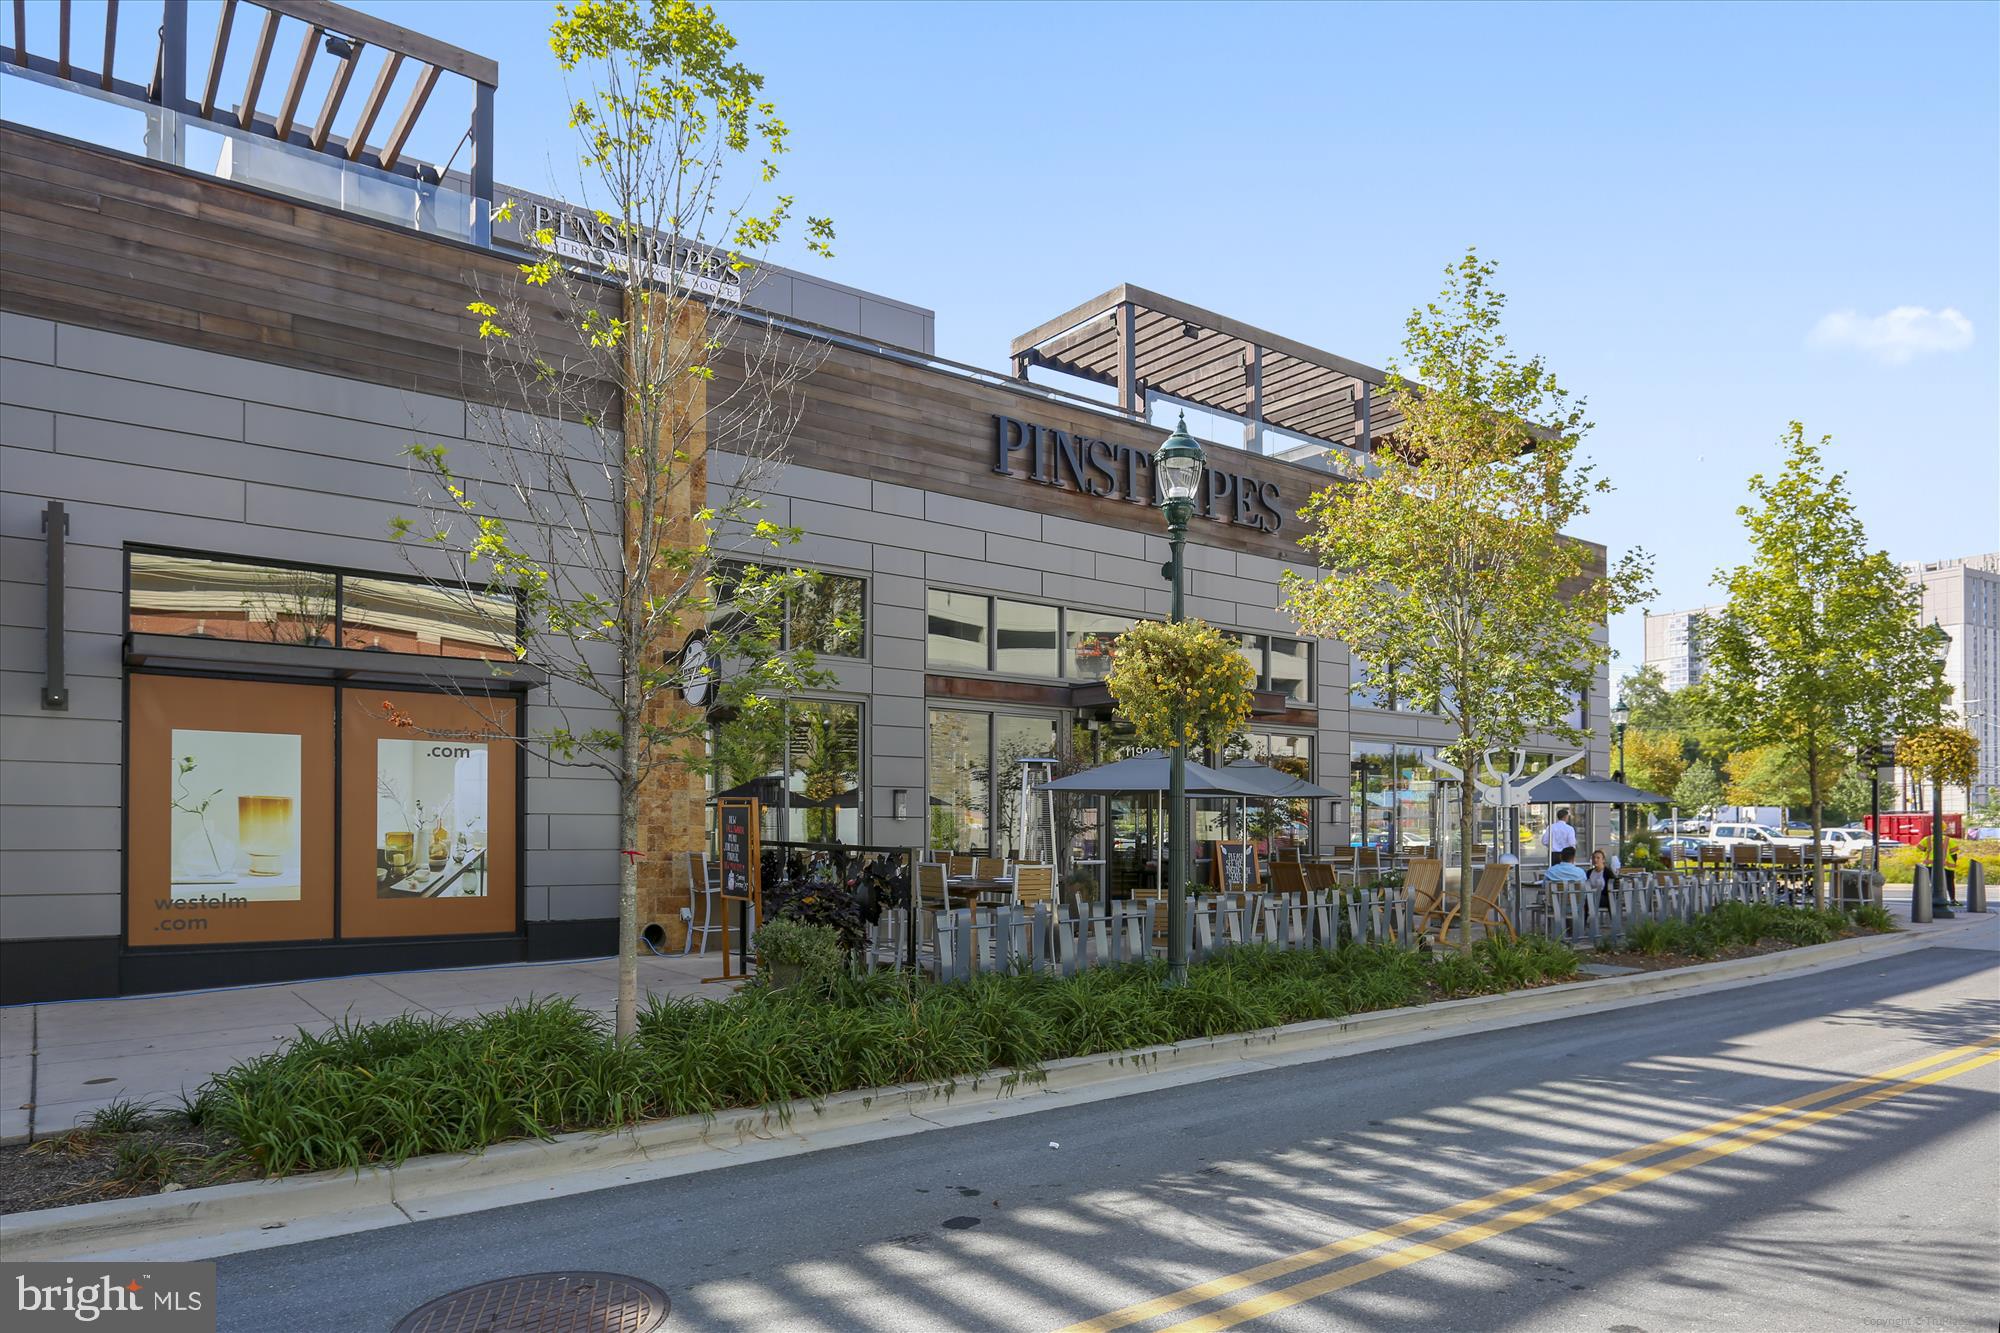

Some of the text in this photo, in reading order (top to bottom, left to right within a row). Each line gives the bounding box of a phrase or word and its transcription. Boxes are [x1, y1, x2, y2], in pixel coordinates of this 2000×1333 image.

[992, 413, 1282, 534] PINSTPES
[426, 746, 470, 758] .com
[154, 892, 248, 910] westelm
[154, 918, 208, 931] .com
